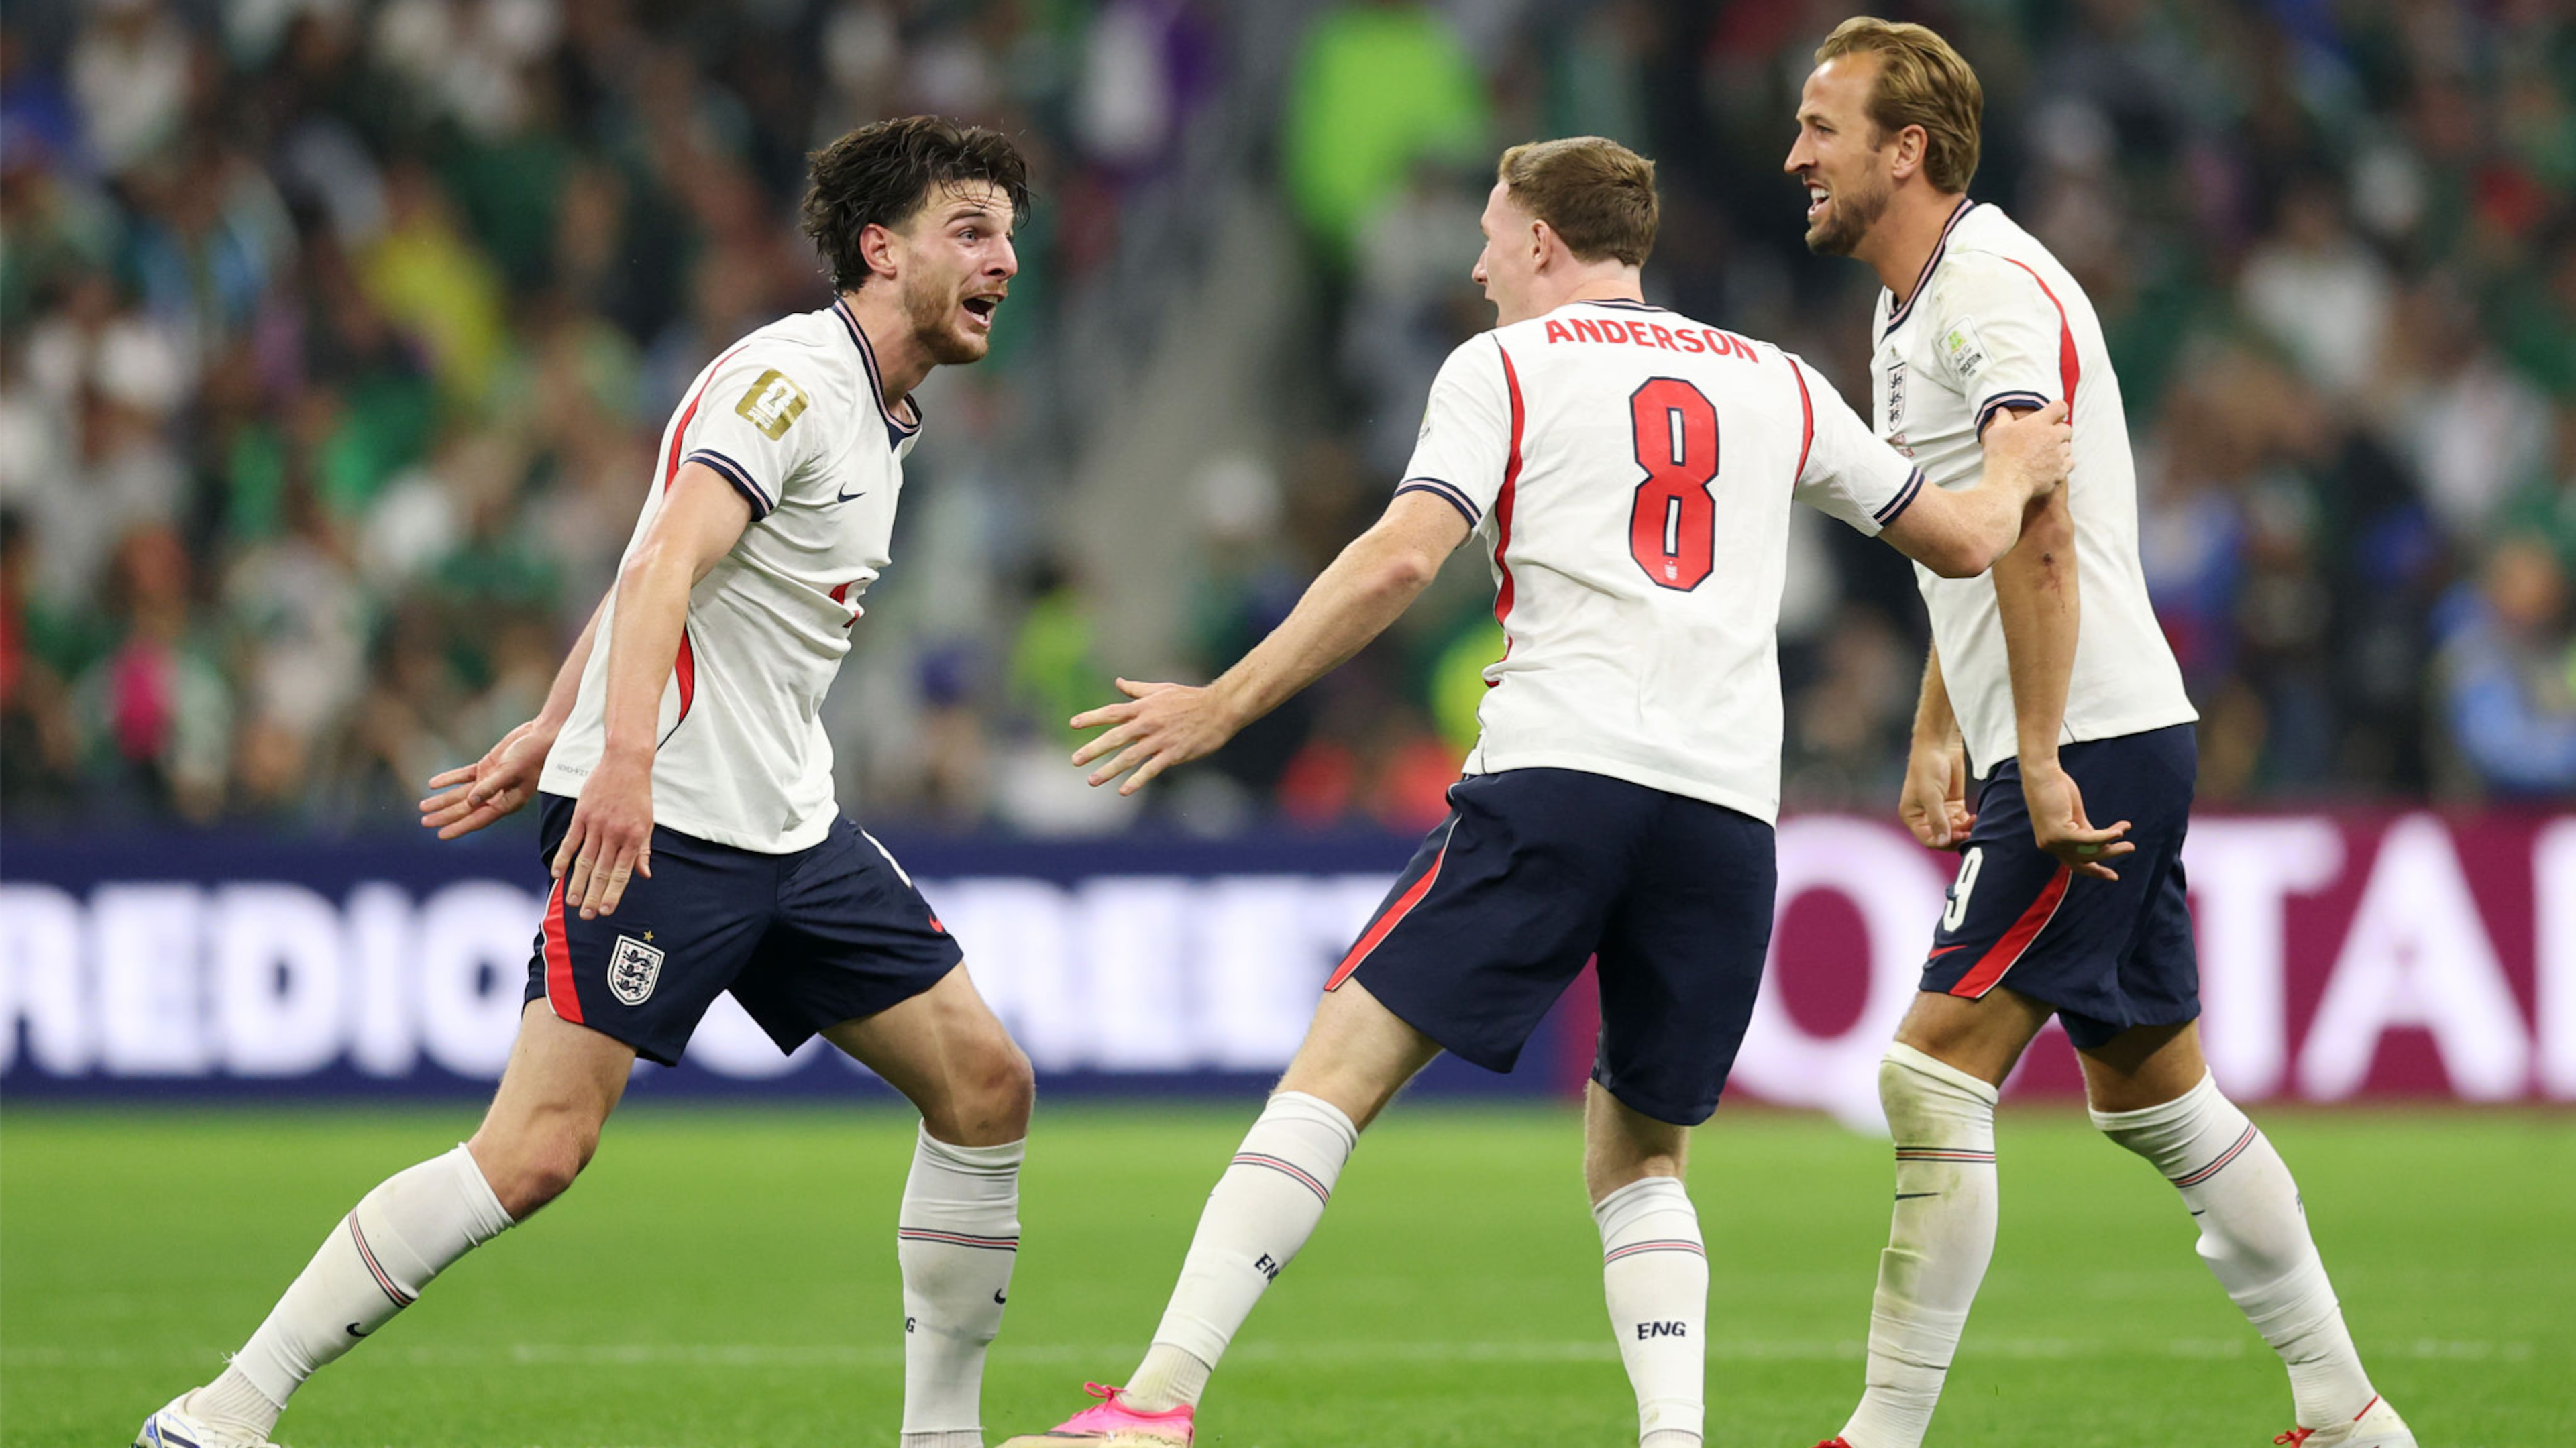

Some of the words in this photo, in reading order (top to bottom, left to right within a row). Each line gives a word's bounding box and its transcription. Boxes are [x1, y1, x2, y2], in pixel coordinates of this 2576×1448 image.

[1545, 318, 1759, 364] ANDERSON
[1629, 377, 1719, 593] 8
[1943, 846, 1984, 932] 9
[1637, 1321, 1686, 1341] ENG
